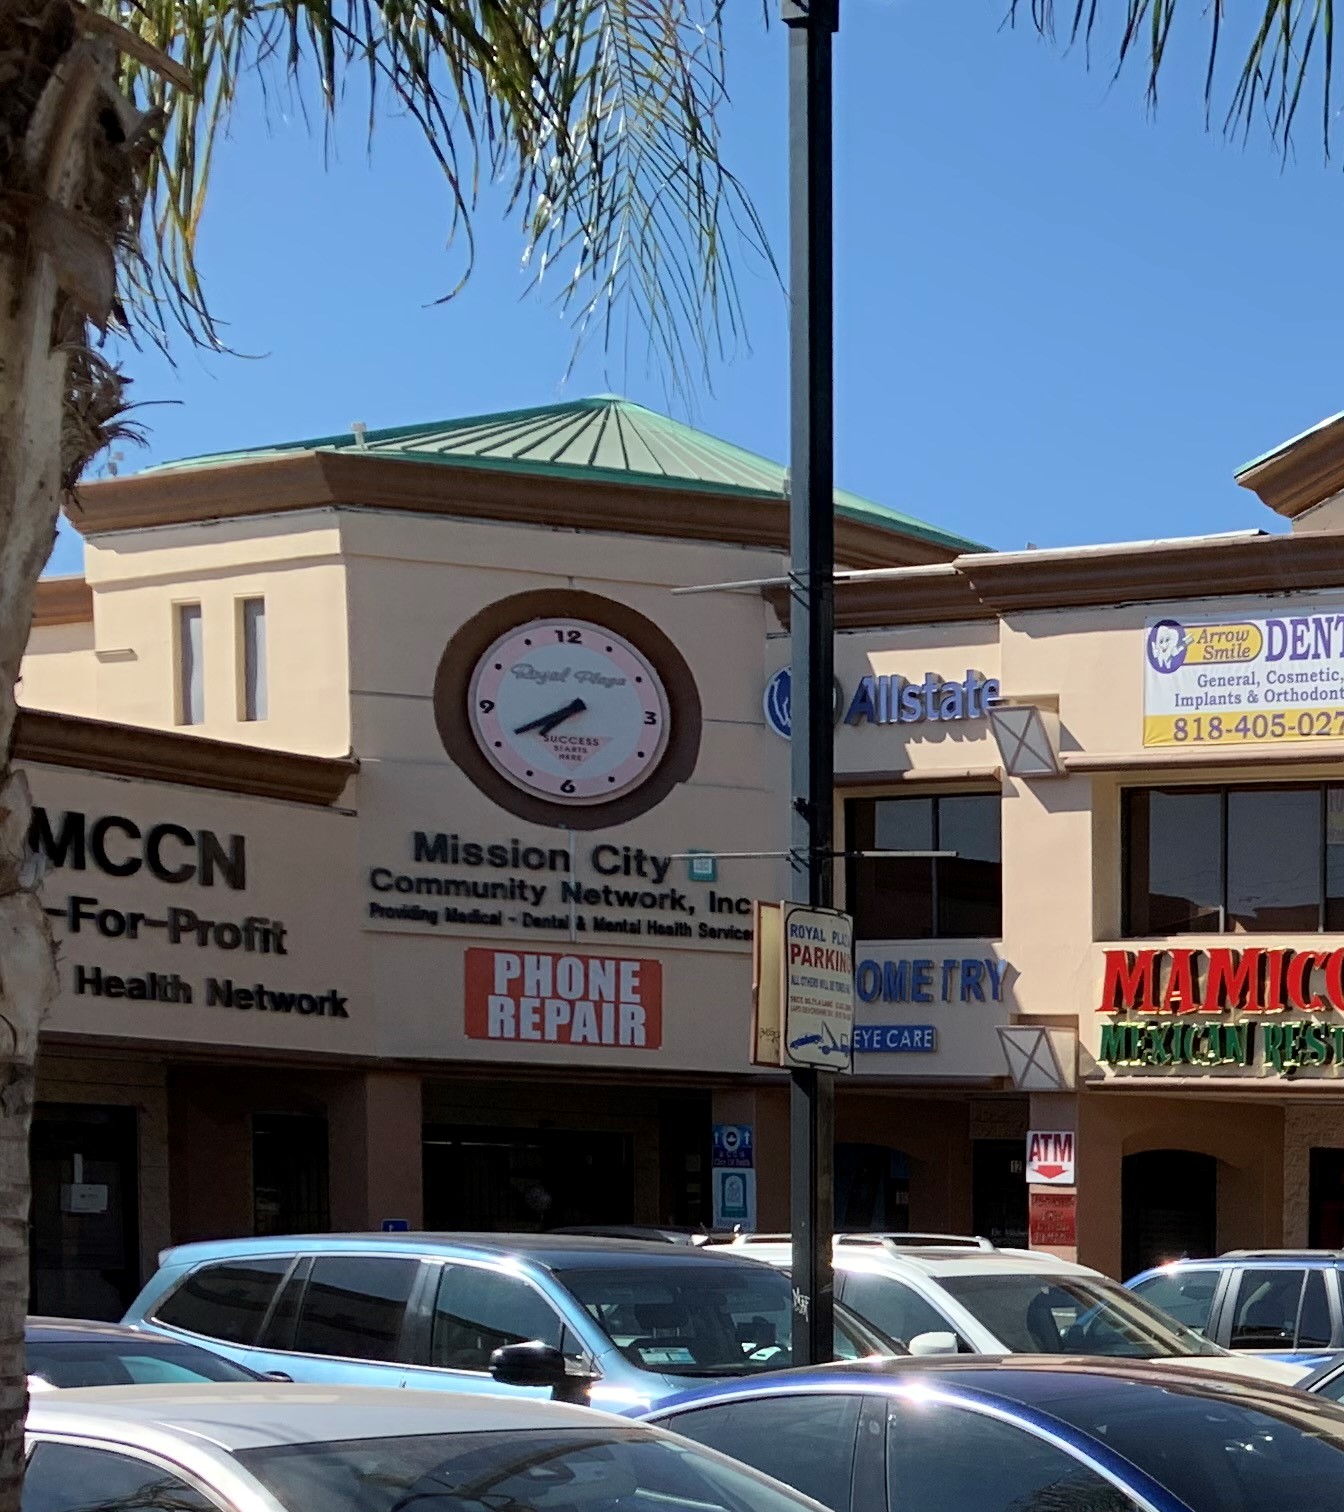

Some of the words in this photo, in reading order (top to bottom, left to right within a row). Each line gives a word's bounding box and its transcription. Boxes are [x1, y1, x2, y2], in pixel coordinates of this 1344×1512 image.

[554, 630, 583, 645] 12
[1197, 628, 1250, 645] Arrow
[1203, 645, 1251, 660] Smile
[1197, 672, 1260, 688] General,
[1266, 667, 1344, 684] Cosmetic,
[480, 700, 495, 714] 9
[844, 670, 1000, 724] Allstate
[1175, 690, 1242, 709] Implants
[1247, 690, 1259, 704] &
[644, 711, 657, 725] 3
[543, 735, 600, 746] SUCCESS
[560, 779, 576, 794] 6
[27, 806, 246, 890] MCCN
[413, 831, 570, 873] Mission
[592, 844, 672, 884] City
[370, 867, 547, 906] Community
[560, 880, 695, 916] Network,
[369, 902, 439, 926] Providing
[445, 904, 503, 927] Medical
[523, 912, 569, 931] Dental
[593, 918, 642, 936] Mental
[647, 920, 692, 938] Health
[790, 923, 826, 943] ROYAL
[494, 952, 641, 1004] PHONE
[74, 964, 194, 1004] Health
[206, 977, 350, 1018] Network
[488, 995, 646, 1047] REPAIR
[853, 1029, 882, 1048] EYE
[886, 1029, 933, 1048] CARE
[1097, 1019, 1251, 1067] MEXICAN
[1029, 1133, 1072, 1163] ATM
